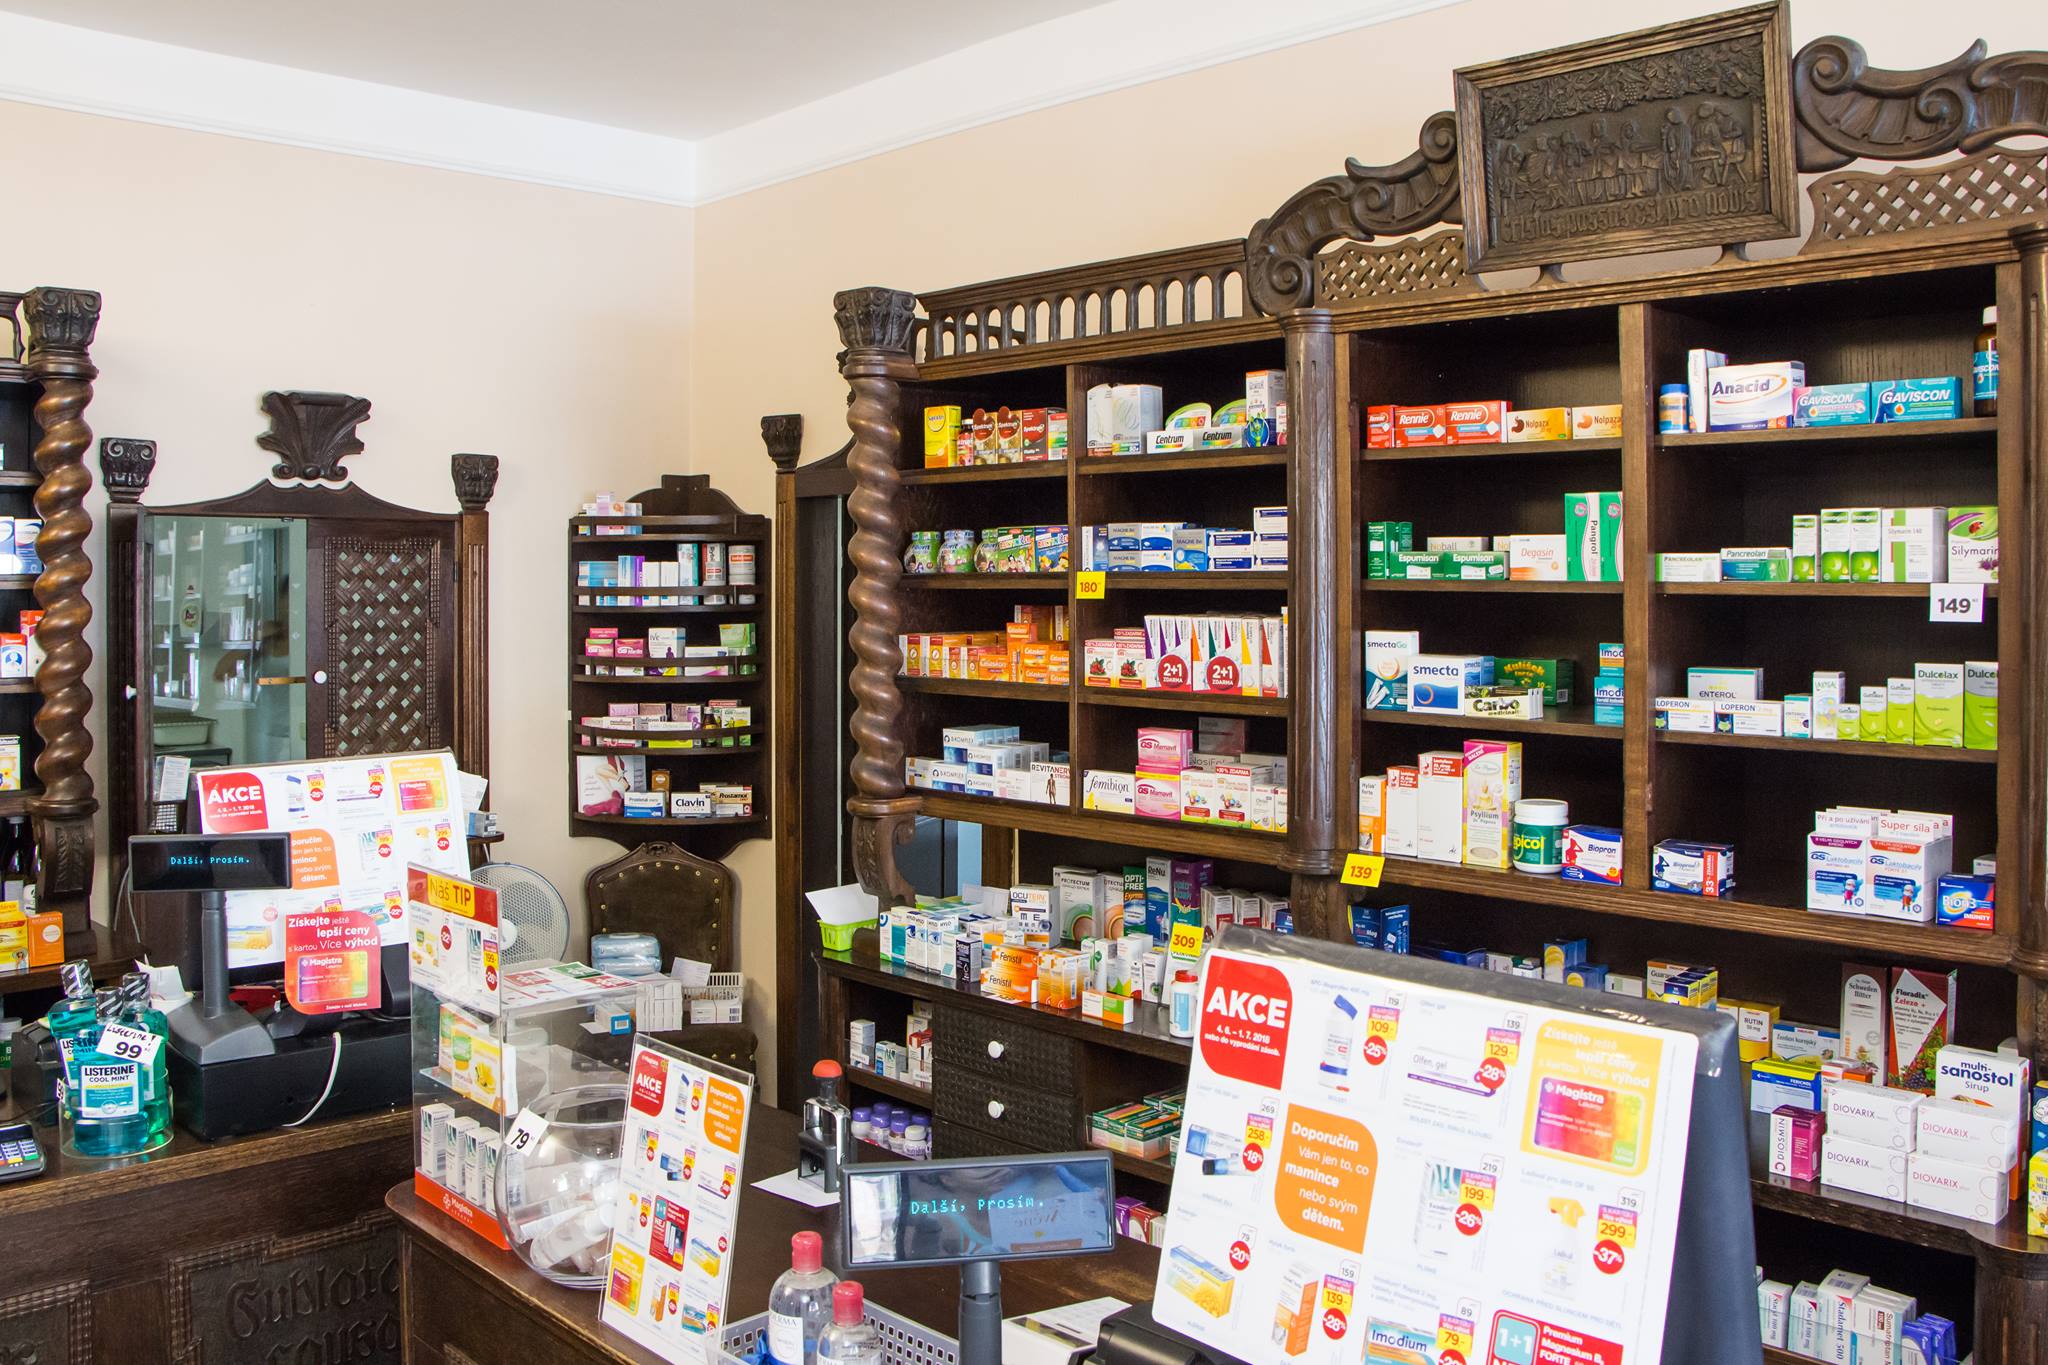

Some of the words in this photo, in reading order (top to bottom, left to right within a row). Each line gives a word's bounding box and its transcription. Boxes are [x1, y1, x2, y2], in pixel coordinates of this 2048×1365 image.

[1711, 378, 1770, 396] Anacid
[1799, 393, 1854, 406] GAVISCON
[1882, 389, 1951, 404] GAVISCON
[1399, 413, 1429, 425] Rennie
[1451, 409, 1483, 421] Rennie
[1155, 434, 1184, 446] Centrum
[1203, 430, 1232, 443] Centrum
[1590, 519, 1598, 555] Pangrol
[1398, 553, 1440, 564] Espumisan
[1452, 553, 1494, 564] Espumisan
[1726, 549, 1767, 559] Pancreolan
[1079, 582, 1098, 594] 180
[1937, 597, 1971, 614] 149
[1163, 662, 1183, 678] 2+1
[1212, 664, 1233, 679] 2+1
[1412, 664, 1459, 677] smecta
[1698, 690, 1737, 700] ENTEROL
[1655, 700, 1691, 709] LOPERON
[1720, 703, 1756, 713] LOPERON
[1086, 775, 1129, 793] femibion
[207, 785, 262, 805] AKCE
[675, 798, 705, 808] Clavin
[1470, 809, 1499, 821] Psyllium
[1880, 818, 1910, 832] Super
[1587, 843, 1617, 855] Biopron
[1124, 874, 1145, 884] OPTI-
[1350, 865, 1373, 879] 139
[429, 878, 450, 902] Náš
[452, 884, 472, 907] TIP
[1124, 882, 1144, 891] FREE
[288, 916, 331, 929] Získejte
[316, 926, 343, 939] lepší
[344, 925, 370, 938] ceny
[319, 939, 342, 950] Více
[344, 936, 379, 949] výhod
[1172, 934, 1196, 948] 309
[999, 951, 1022, 965] Fenistil
[988, 974, 1013, 988] Fenistil
[1206, 986, 1288, 1029] AKCE
[1744, 1016, 1764, 1027] RUTIN
[114, 1041, 142, 1059] 99
[84, 1064, 135, 1077] LISTERINE
[1960, 1059, 1992, 1073] multi-
[88, 1075, 110, 1083] COOL
[111, 1074, 130, 1082] MINT
[1940, 1064, 2014, 1088] sanostol
[635, 1072, 663, 1095] AKCE
[1965, 1080, 1990, 1094] Sirup
[1555, 1083, 1605, 1105] Magistra
[1832, 1102, 1876, 1120] DIOVARIX
[1291, 1120, 1360, 1152] Doporučím
[1922, 1121, 1969, 1139] DIOVARIX
[510, 1127, 531, 1151] 79
[1777, 1117, 1786, 1161] DIOSMIN
[1298, 1146, 1321, 1162] Vám
[1322, 1151, 1338, 1168] jen
[1355, 1163, 1370, 1176] co
[1826, 1150, 1871, 1169] DIOVARIX
[1482, 1161, 1498, 1174] 219
[1285, 1162, 1340, 1188] mamince
[1911, 1170, 1960, 1189] DIOVARIX
[1298, 1186, 1328, 1205] nebo
[1328, 1196, 1359, 1215] svým
[1620, 1196, 1638, 1209] 319
[910, 1199, 967, 1217] Další,
[1301, 1206, 1345, 1232] dětem.
[1460, 1305, 1473, 1318] 89
[1371, 1329, 1428, 1354] Imodium
[1499, 1327, 1535, 1356] 1+1
[1542, 1325, 1584, 1347] Premium
[1541, 1338, 1592, 1362] Magnesium
[1835, 1344, 1844, 1361] 500
[1539, 1351, 1572, 1365] FORTE
